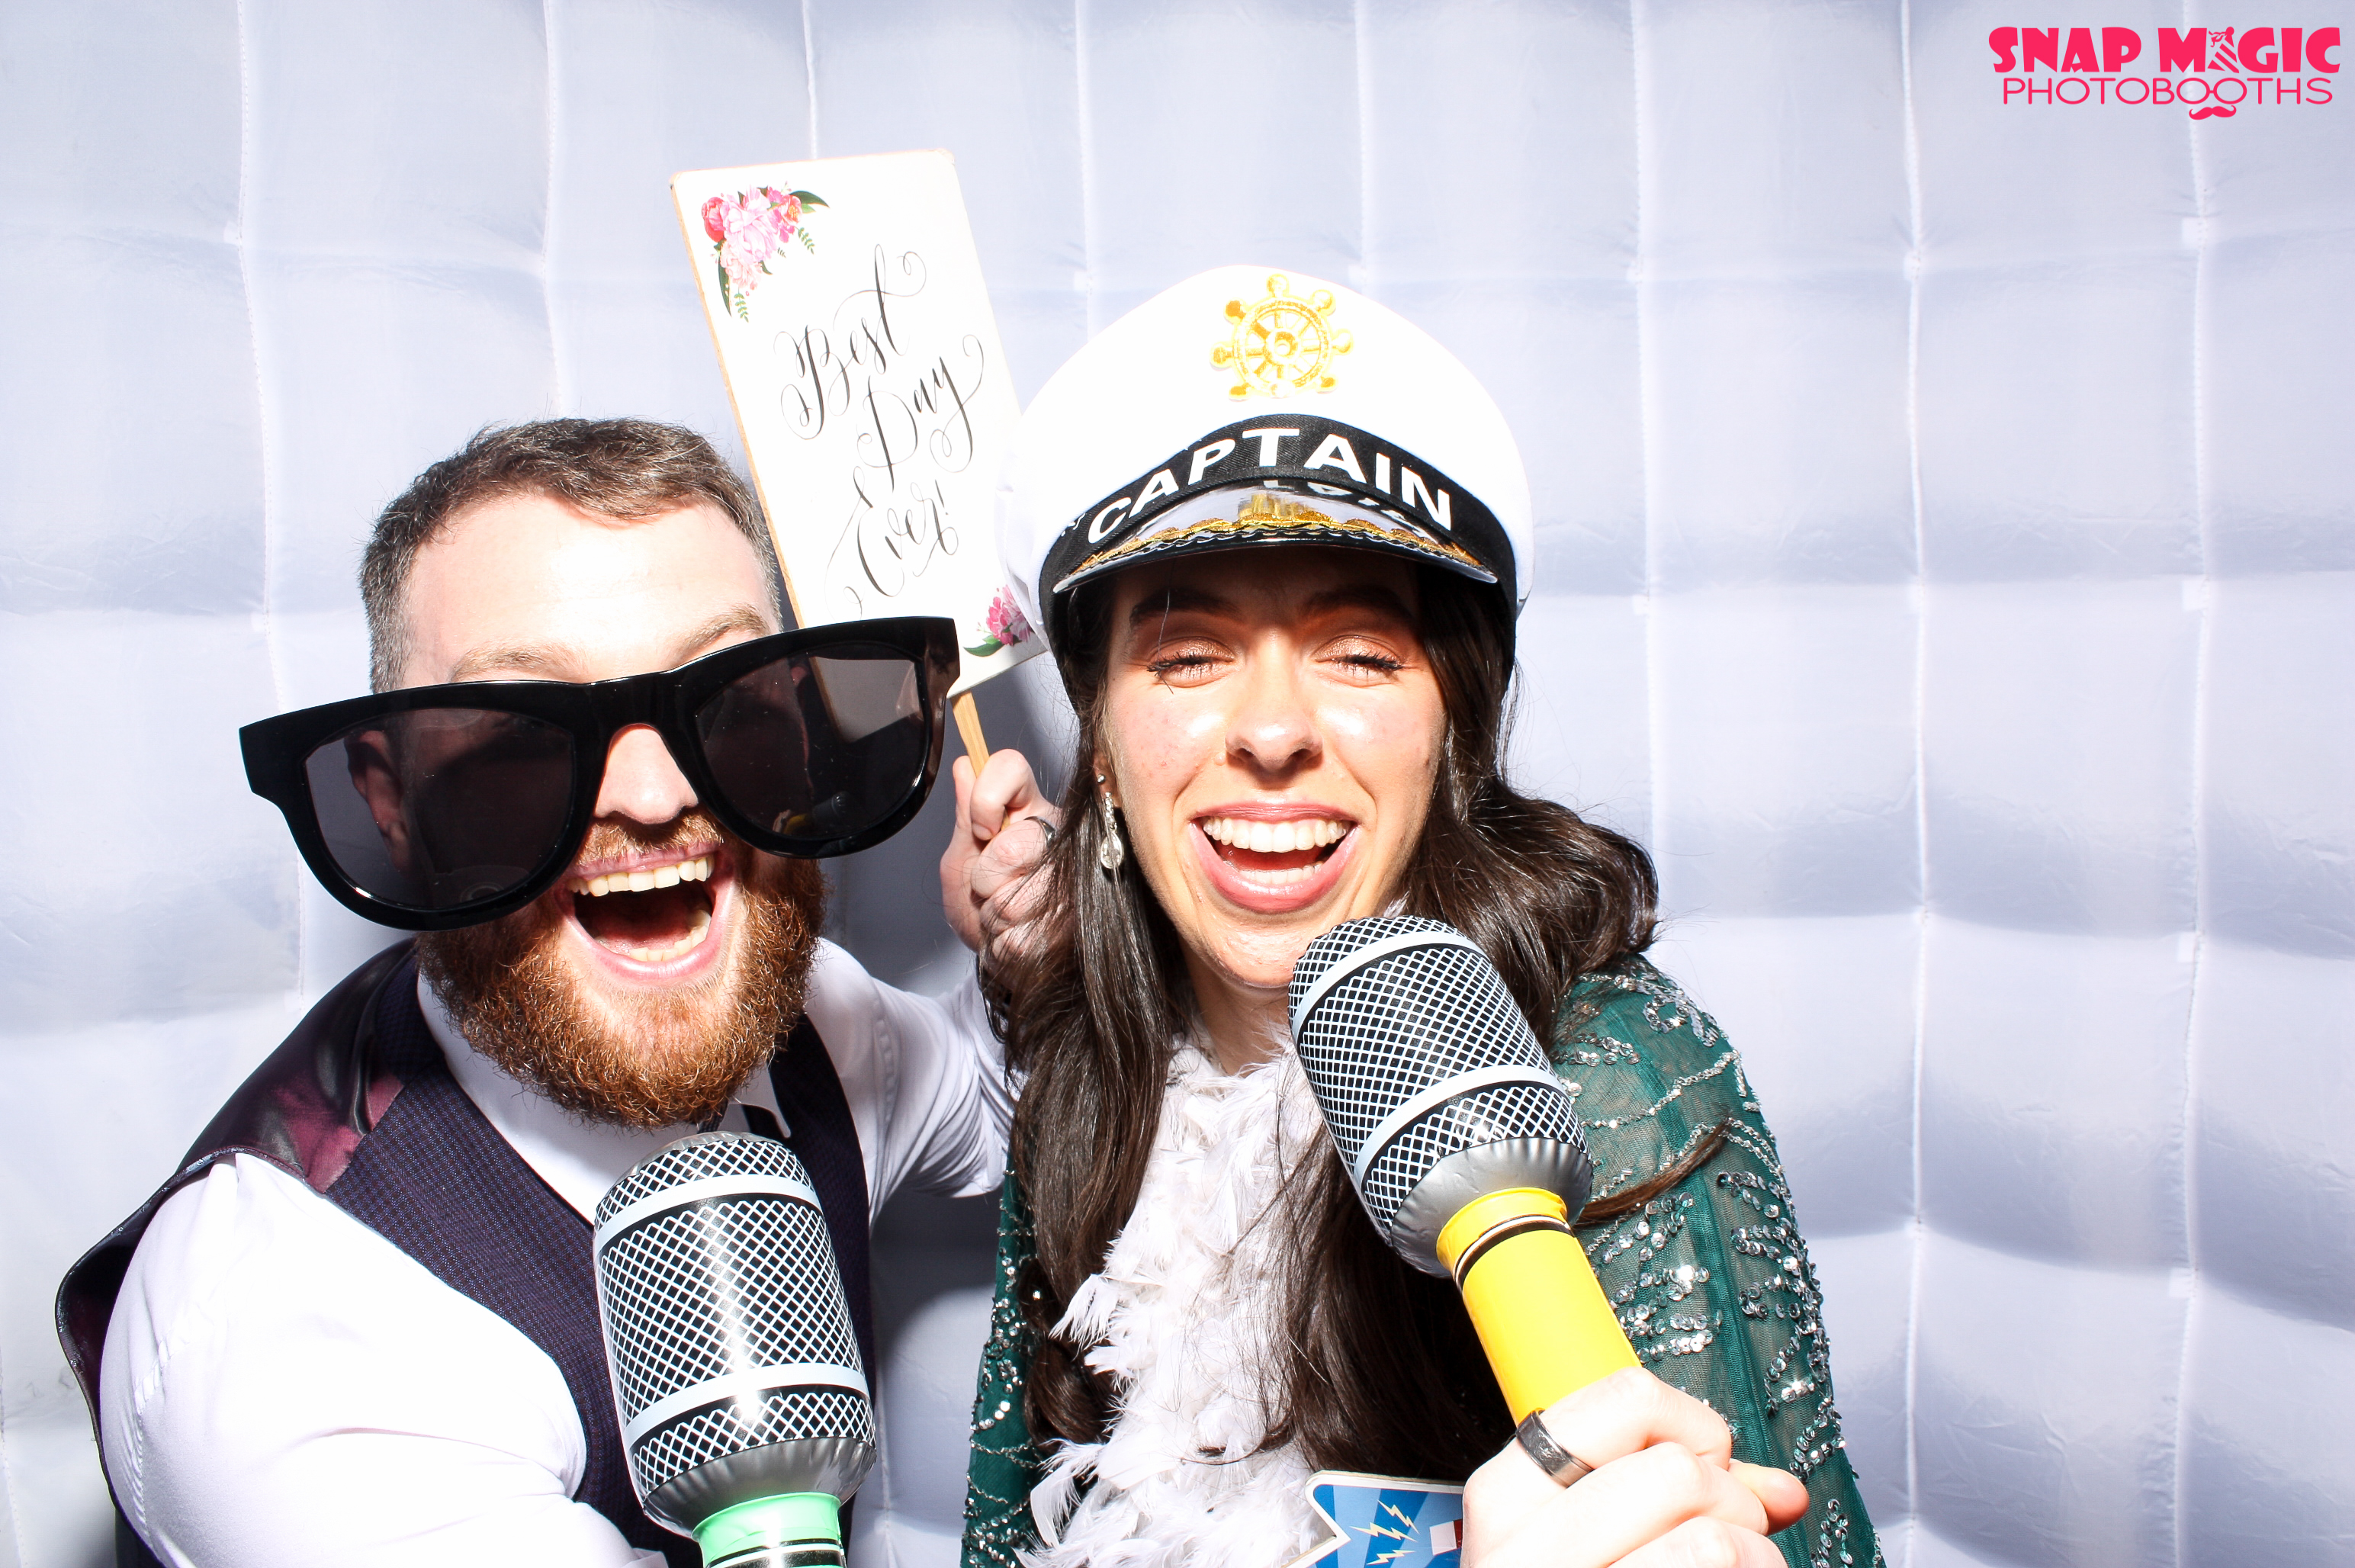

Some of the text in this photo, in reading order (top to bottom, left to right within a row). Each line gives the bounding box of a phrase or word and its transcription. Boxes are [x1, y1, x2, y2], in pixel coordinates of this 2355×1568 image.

[774, 243, 927, 440] Best
[857, 334, 984, 493] Day
[824, 466, 959, 621] Ever!
[1088, 427, 1452, 545] CAPTAIN
